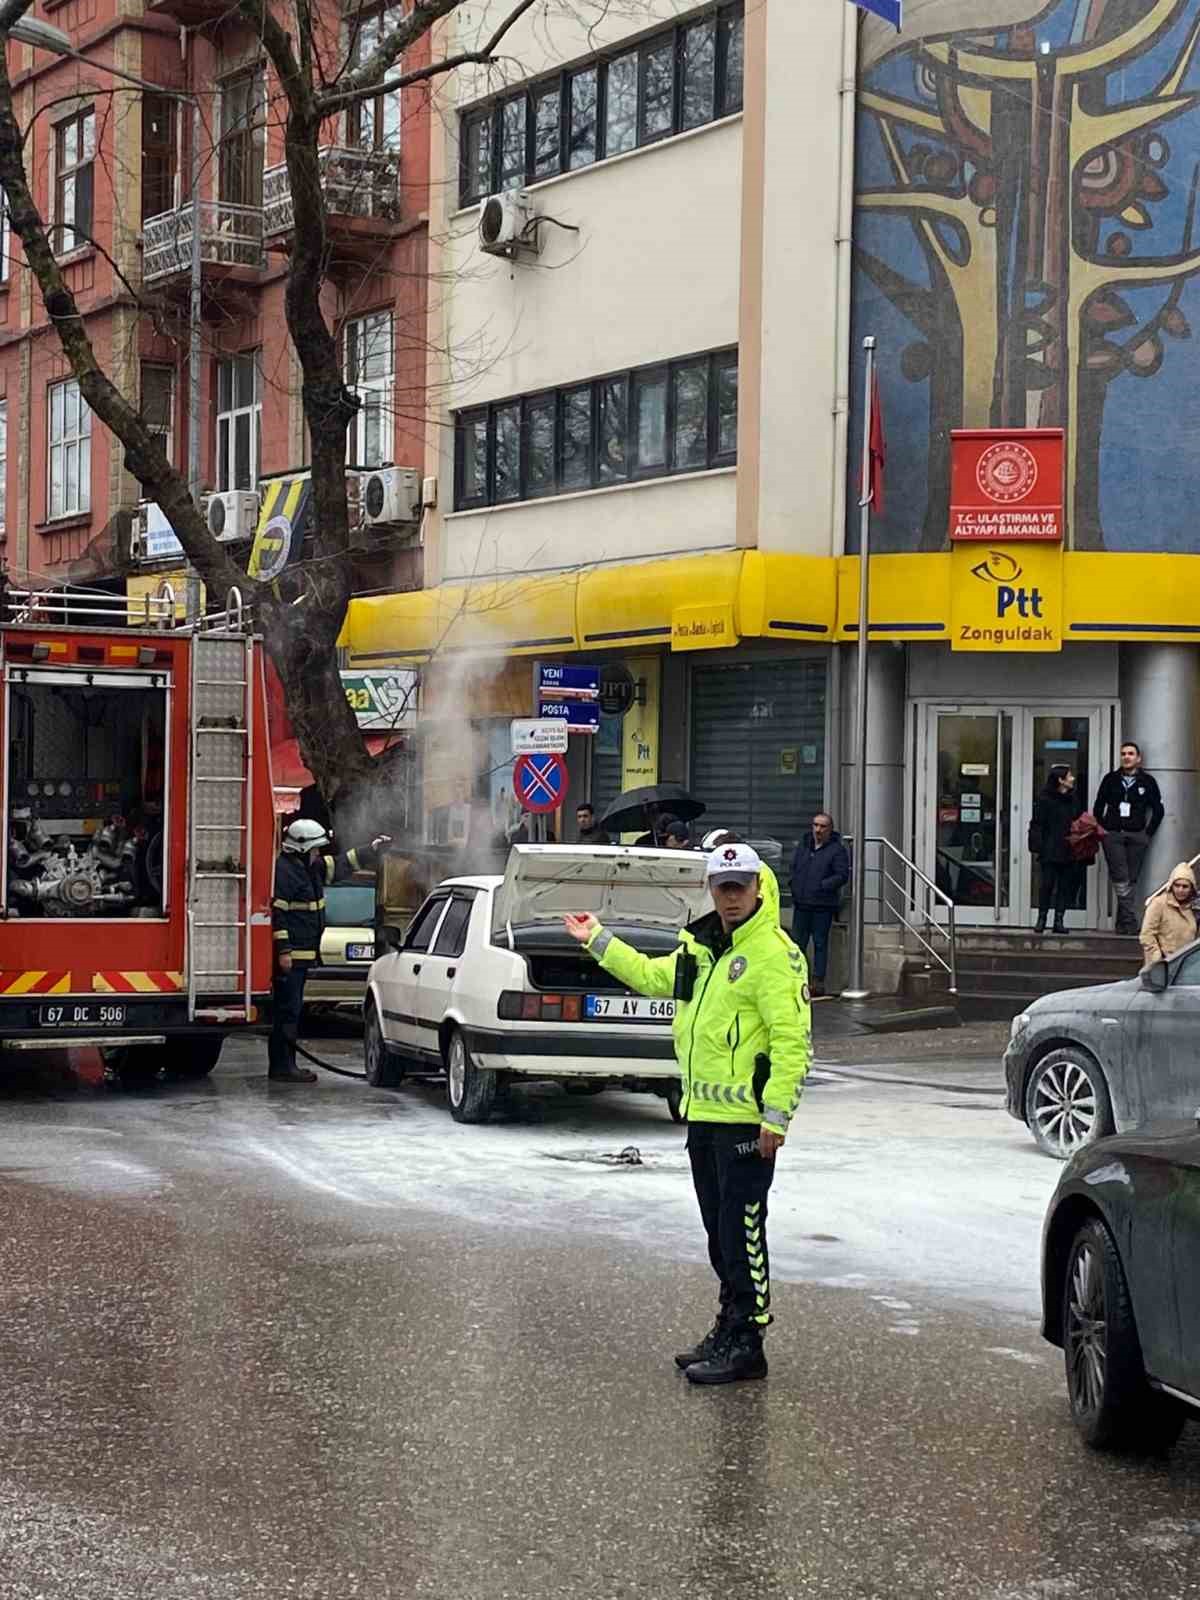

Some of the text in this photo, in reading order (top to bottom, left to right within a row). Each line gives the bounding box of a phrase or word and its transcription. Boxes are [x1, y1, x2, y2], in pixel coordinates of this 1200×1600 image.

[957, 513, 1055, 525] T.C. ULAŞTIRMA VE
[955, 523, 1057, 535] ALTYAPI BAKANLIĞI
[997, 586, 1043, 618] Ptt
[961, 626, 1053, 643] Zonguldak
[542, 704, 570, 716] POSTA
[47, 1007, 63, 1021] 67
[100, 1007, 122, 1021] 506
[595, 1000, 674, 1016] 67 AV 646
